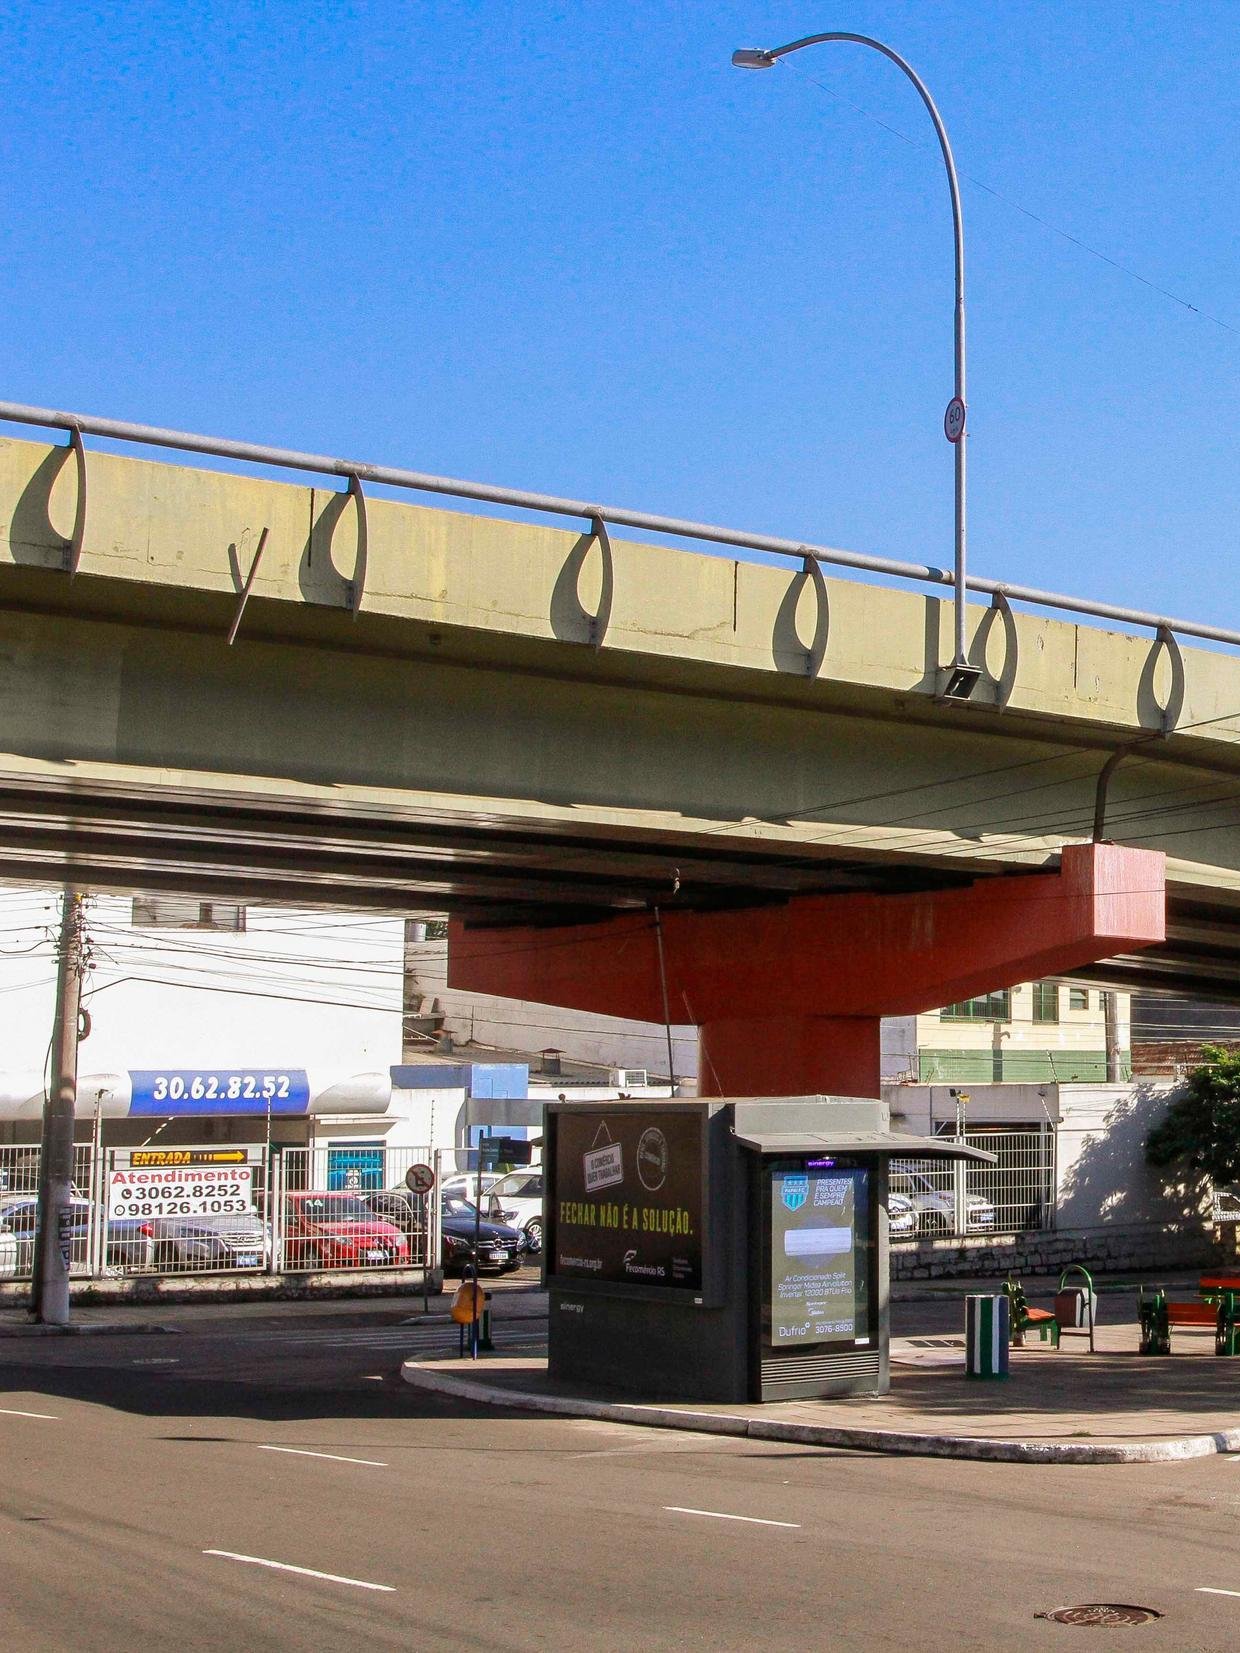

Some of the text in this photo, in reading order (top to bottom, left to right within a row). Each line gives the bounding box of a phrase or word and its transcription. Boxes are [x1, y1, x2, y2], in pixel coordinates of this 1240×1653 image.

[950, 406, 961, 424] 60
[153, 1076, 290, 1100] 30.62.82.52
[132, 1151, 191, 1166] ENTRADA
[112, 1168, 251, 1184] Atendimento
[135, 1184, 241, 1200] 3062.8252
[128, 1199, 247, 1216] 98126.1053
[560, 1201, 694, 1237] FECHAR NÃO É A SOLUÇÃO.
[778, 1326, 807, 1337] Dufrio
